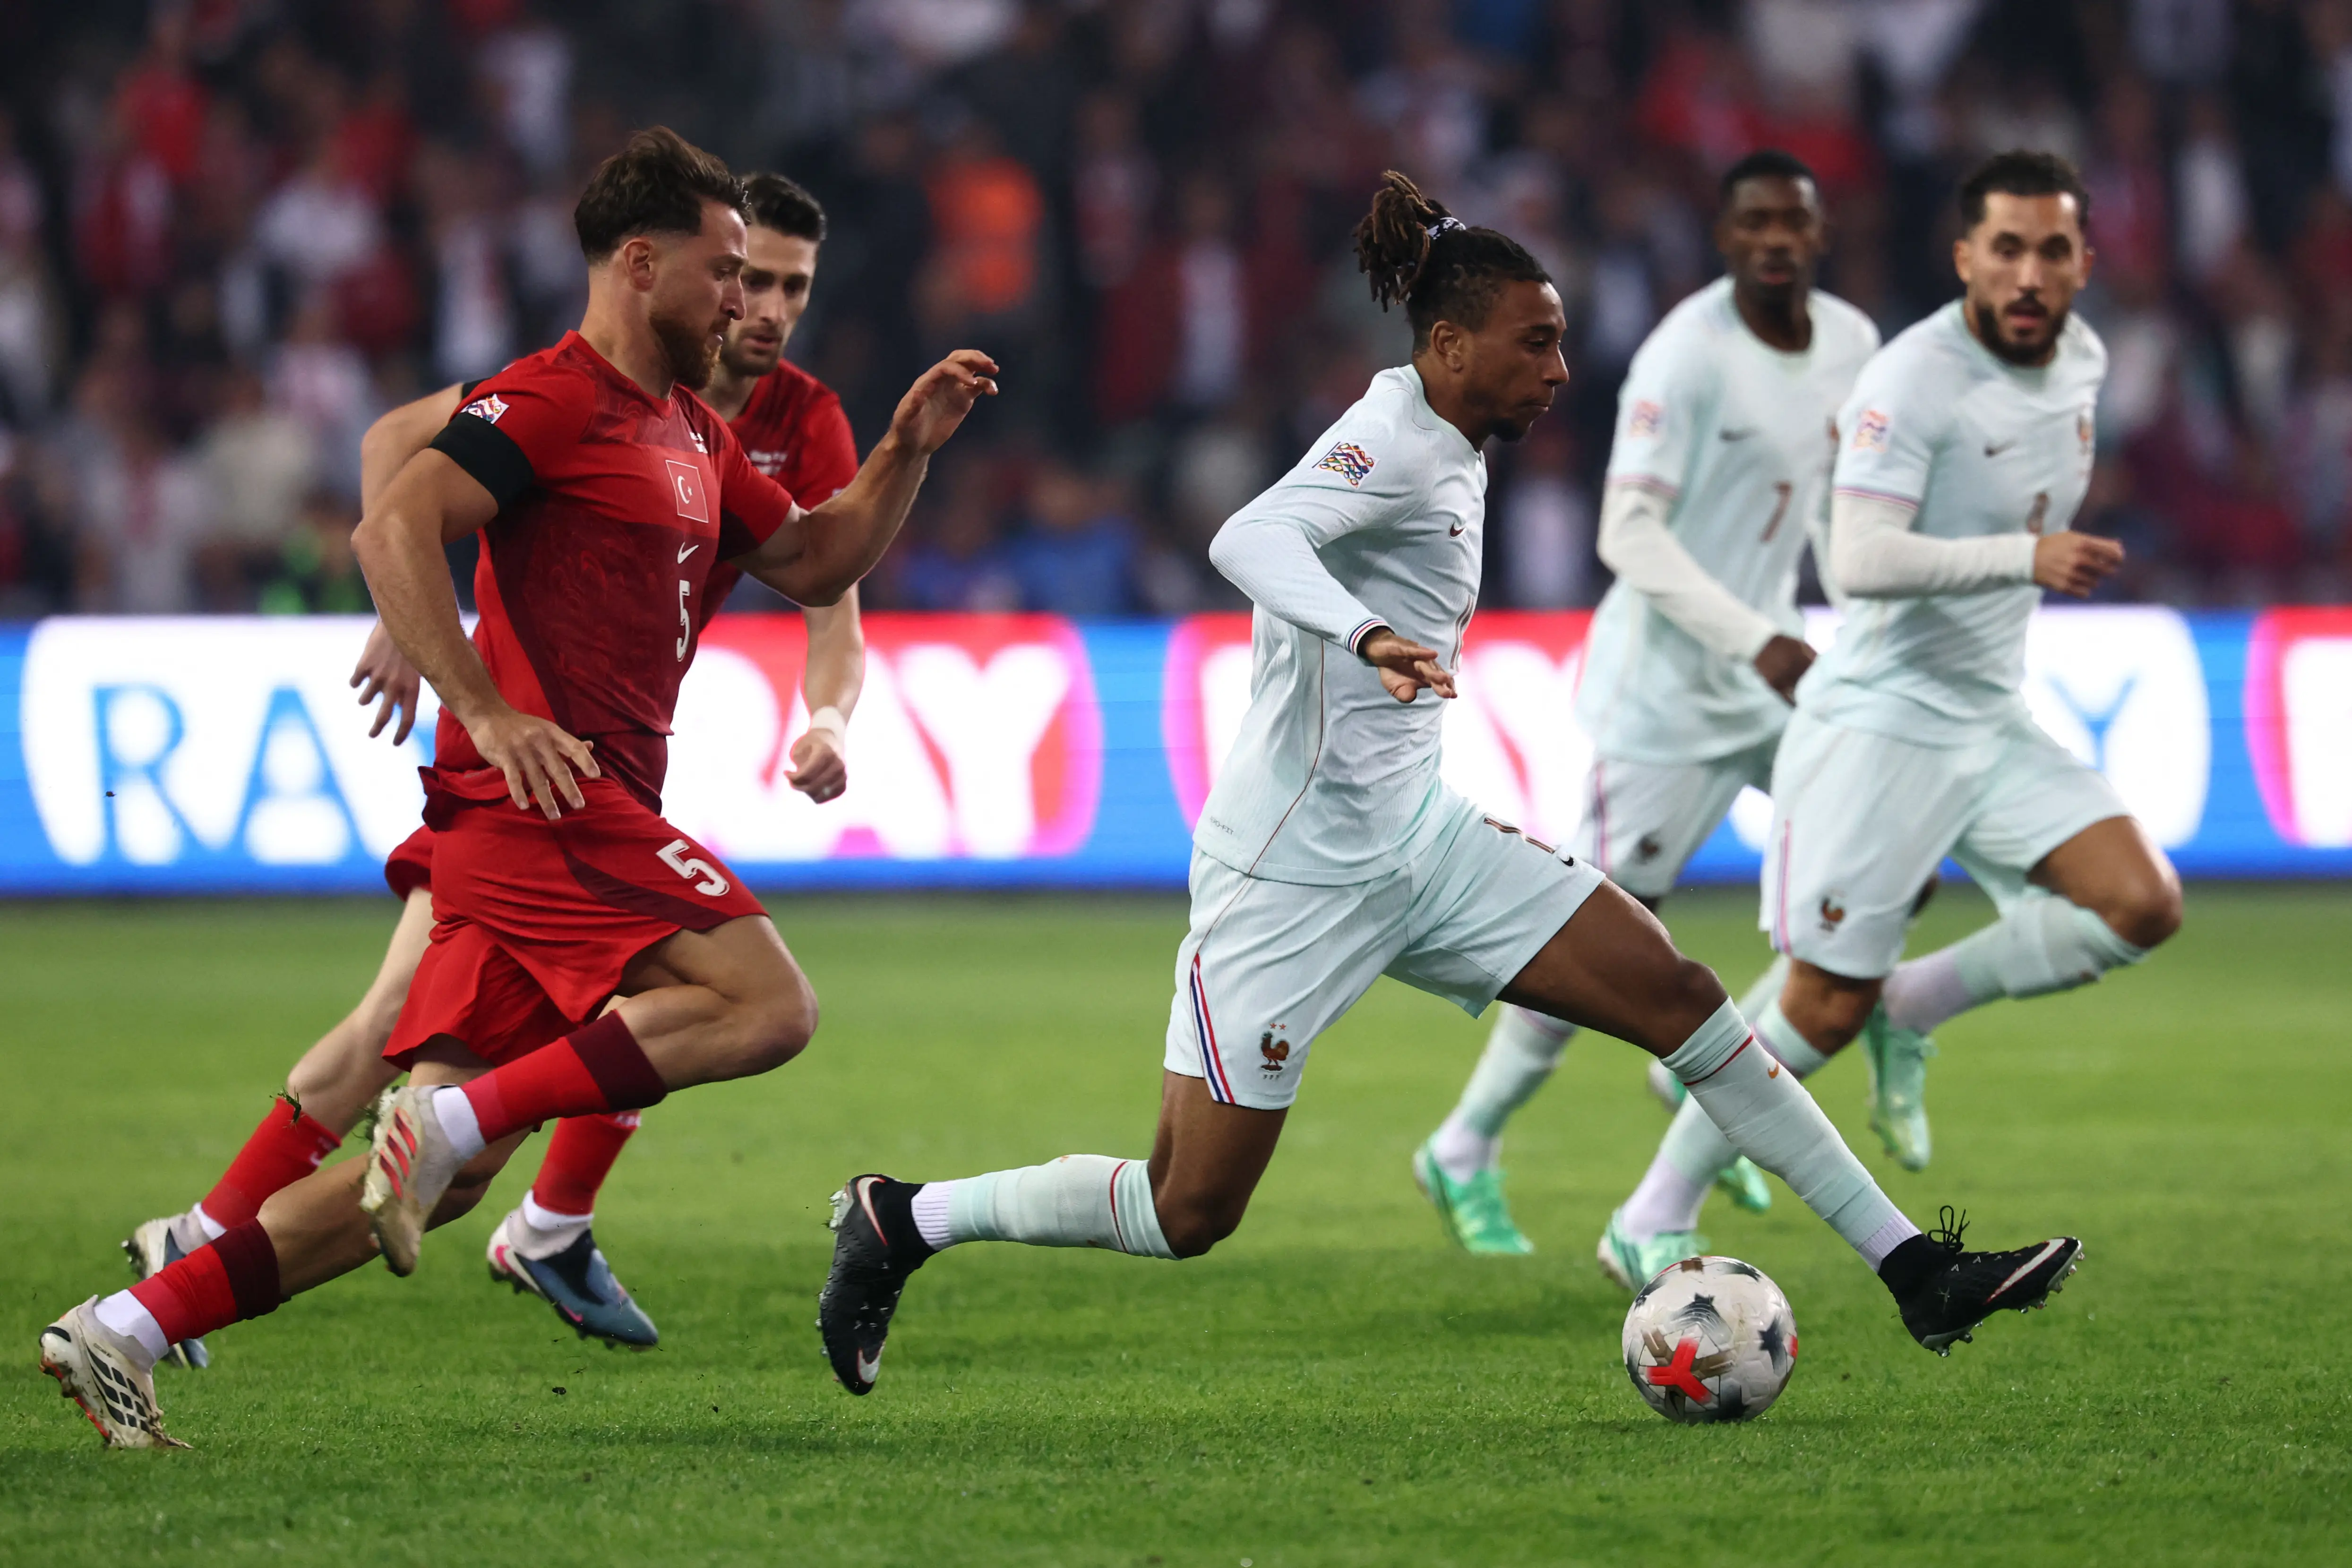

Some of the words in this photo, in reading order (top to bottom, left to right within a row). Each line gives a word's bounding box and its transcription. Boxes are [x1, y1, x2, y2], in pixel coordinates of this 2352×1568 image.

[1759, 480, 1793, 544] 7
[677, 579, 690, 662] 5
[93, 683, 437, 857] RA
[655, 839, 730, 896] 5
